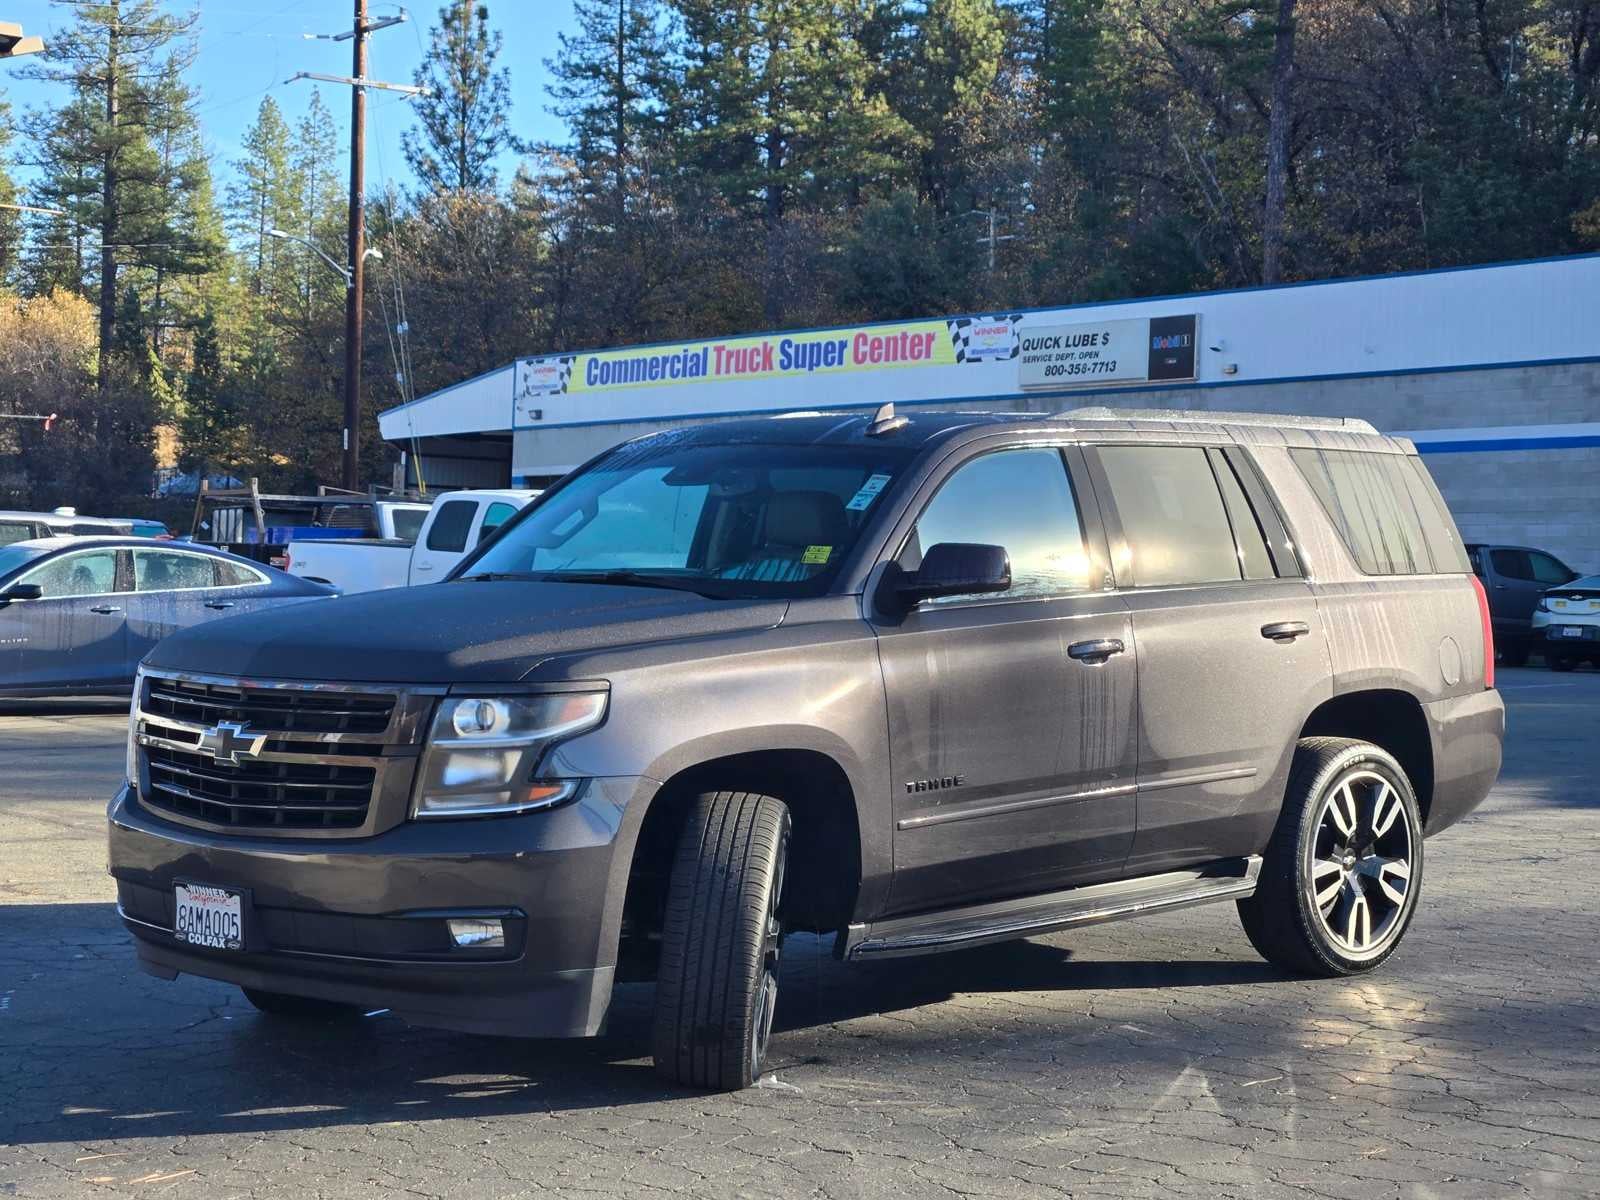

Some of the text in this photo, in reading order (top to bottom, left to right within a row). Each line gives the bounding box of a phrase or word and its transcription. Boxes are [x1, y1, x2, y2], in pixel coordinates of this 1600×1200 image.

[1022, 336, 1063, 352] QUICK
[1065, 333, 1099, 348] LUBE
[586, 332, 936, 386] Commercial Truck Super Center
[1022, 354, 1053, 364] SERVICE
[1078, 350, 1100, 360] OPEN
[1044, 360, 1117, 377] 800-358-7713
[187, 883, 226, 899] WINNER
[178, 904, 239, 940] 8AMA005
[188, 933, 226, 949] COLFAX
